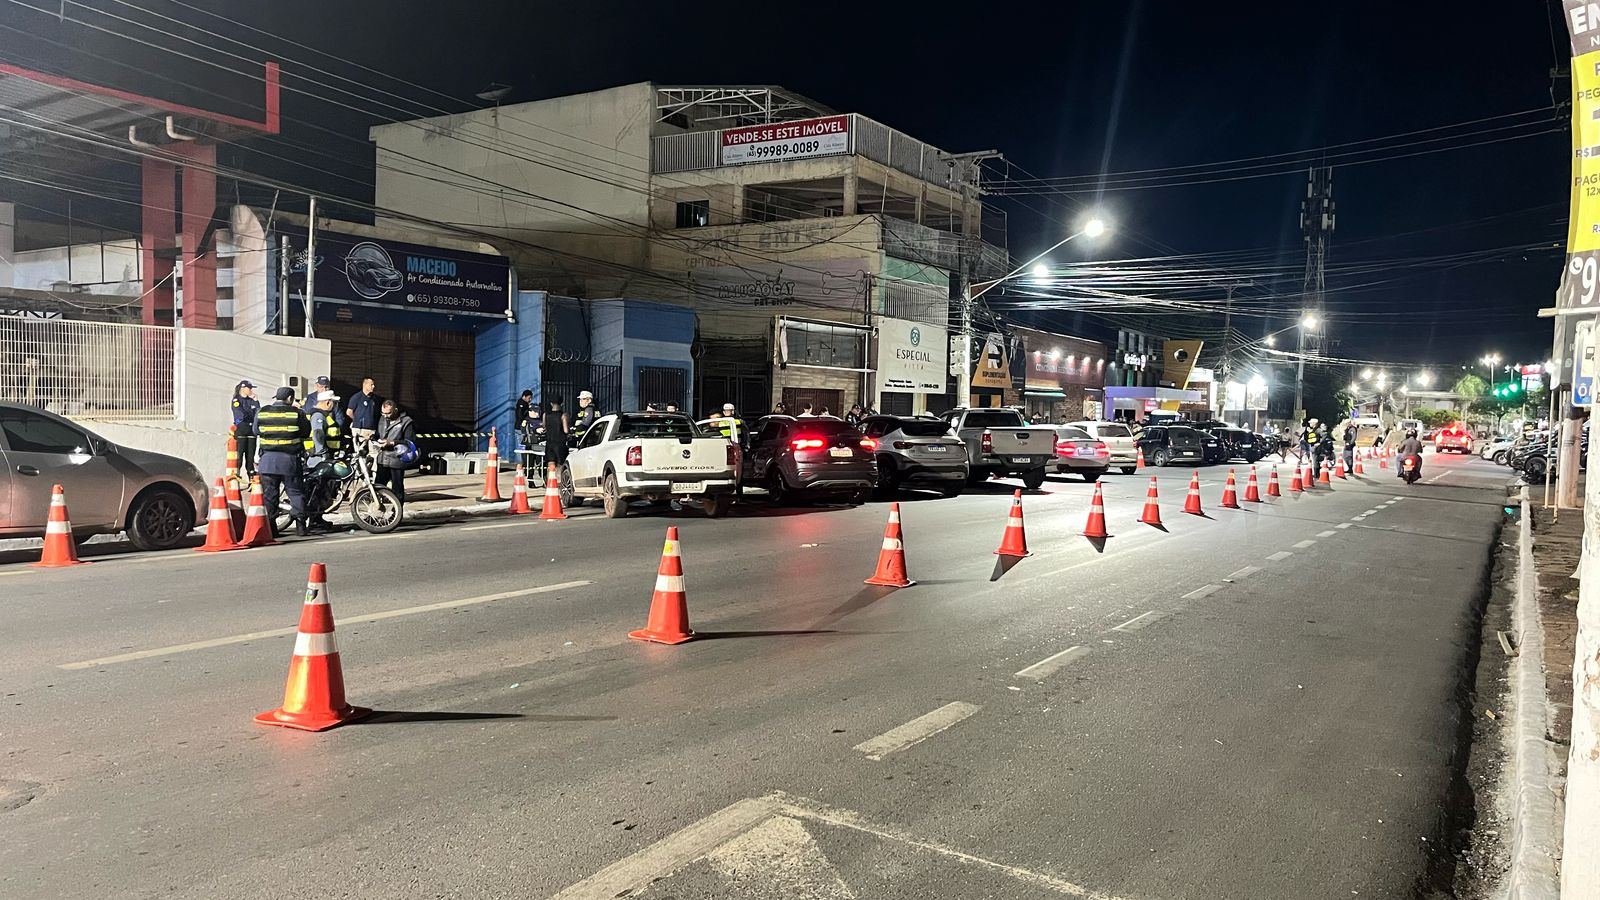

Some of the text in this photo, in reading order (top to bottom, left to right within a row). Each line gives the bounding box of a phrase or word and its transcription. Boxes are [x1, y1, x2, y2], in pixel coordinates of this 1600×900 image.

[726, 120, 843, 144] VENDE-SE ESTE IMÓVEL
[756, 140, 819, 158] 99989-0089
[1575, 173, 1600, 186] PAG
[406, 256, 457, 277] MACEDO
[407, 273, 503, 291] Ar Condicionado Automotivo
[772, 281, 795, 296] CAT
[1581, 256, 1600, 305] 9
[413, 294, 480, 307] (65) 99308-7580
[896, 348, 932, 362] ESPECIAL
[1578, 383, 1592, 397] Ô
